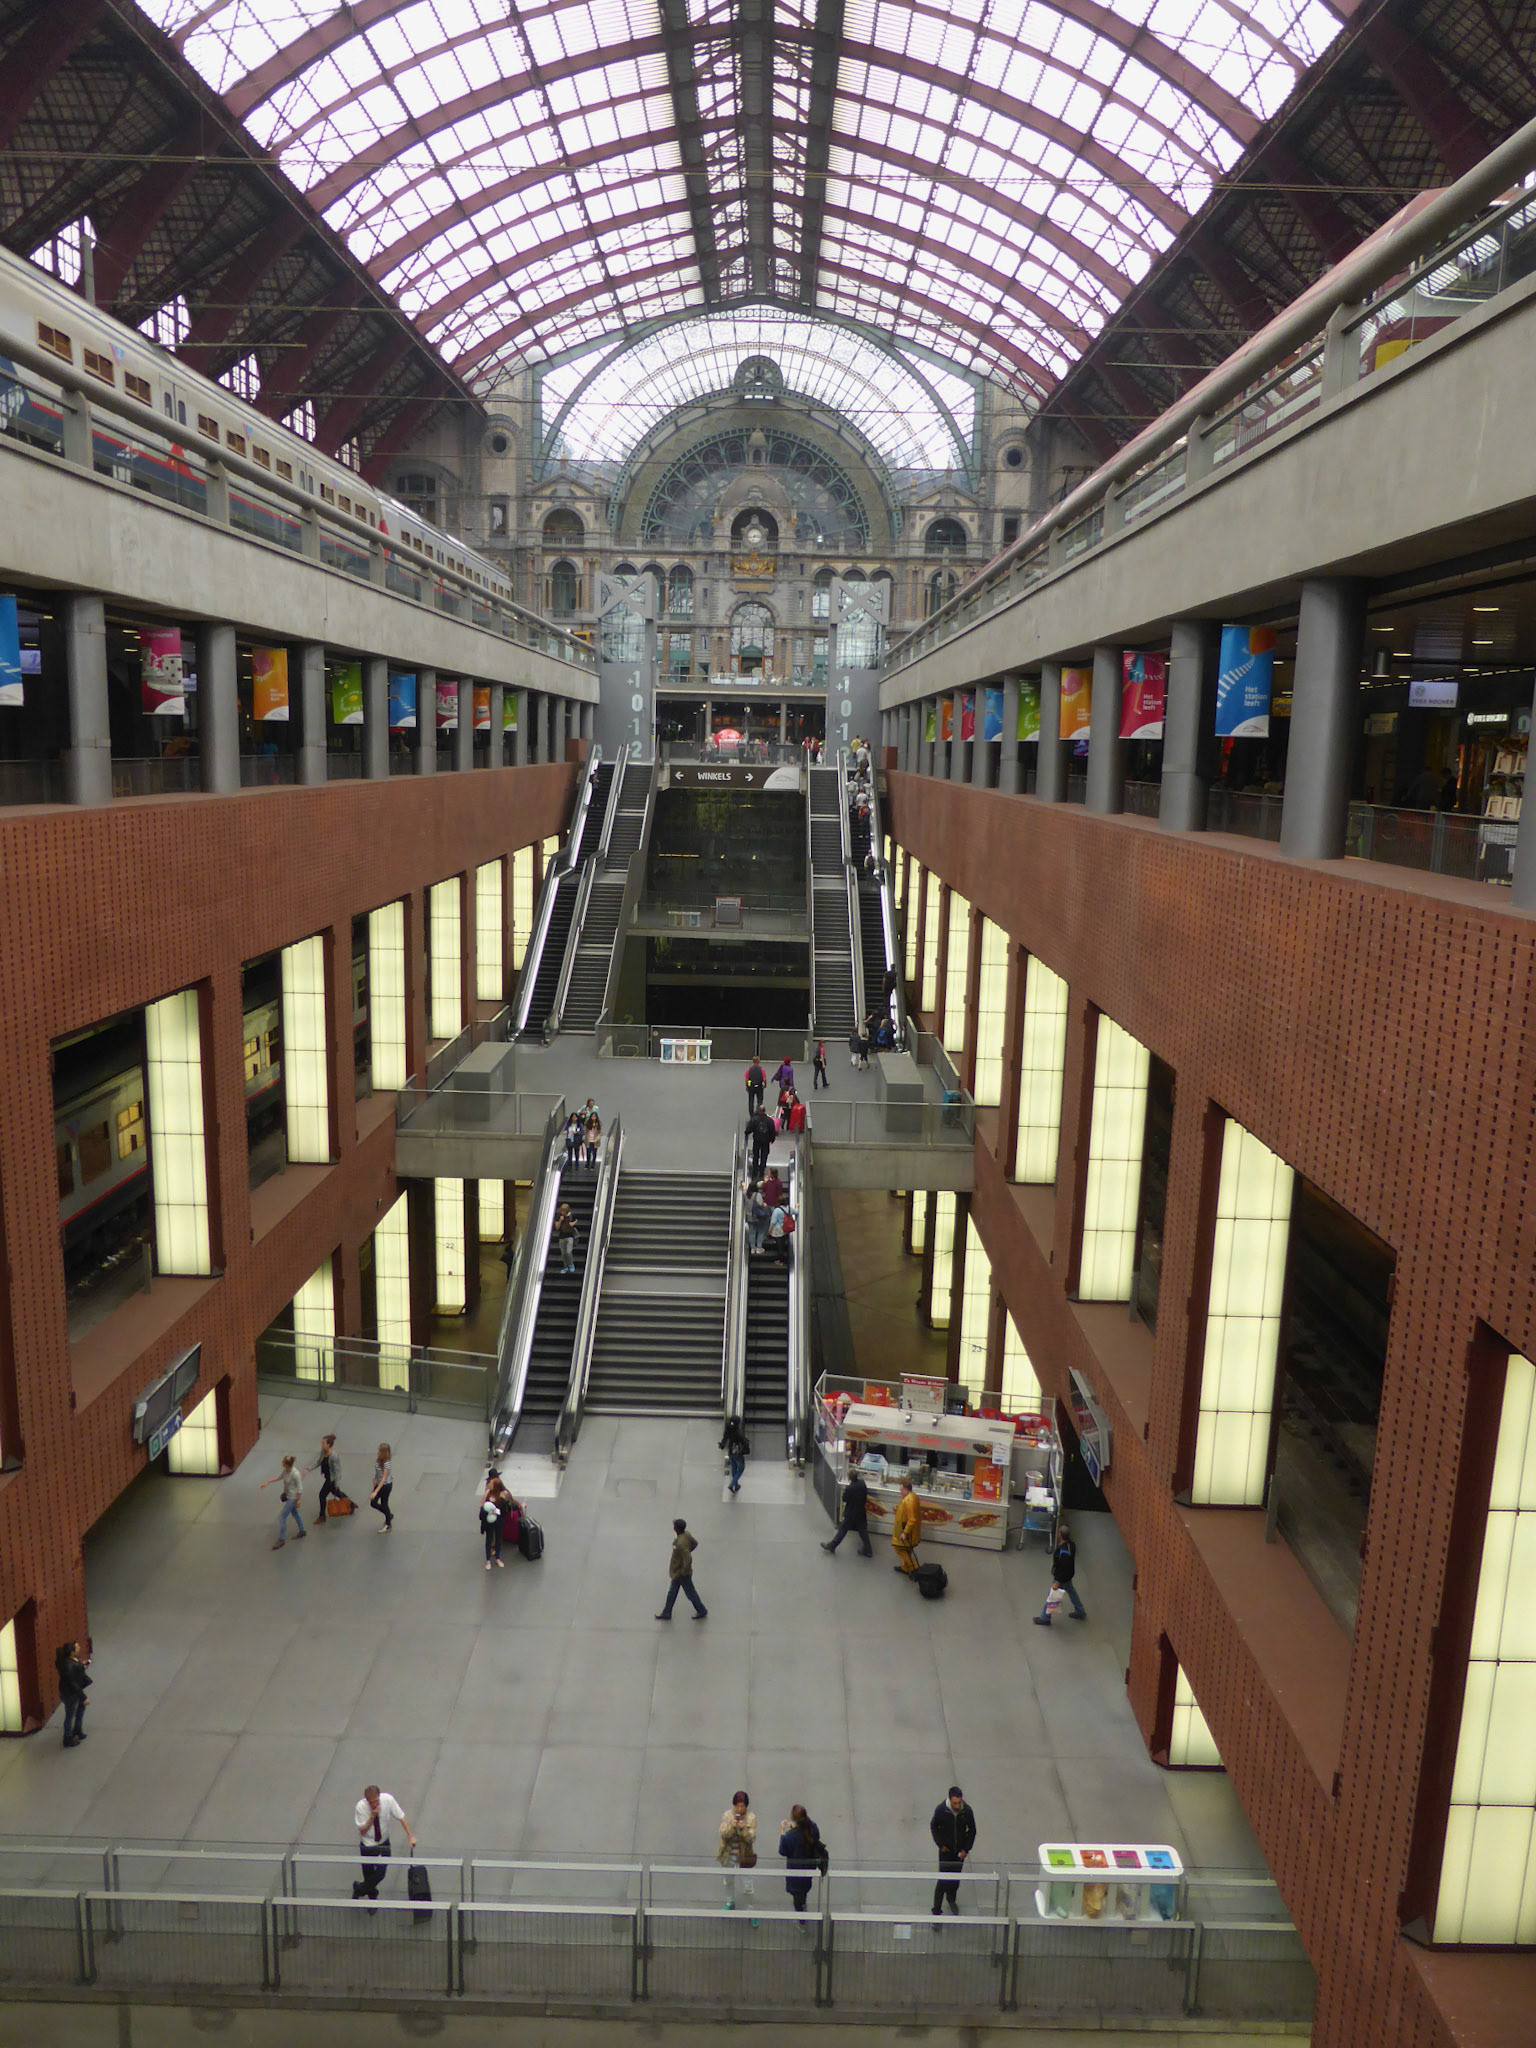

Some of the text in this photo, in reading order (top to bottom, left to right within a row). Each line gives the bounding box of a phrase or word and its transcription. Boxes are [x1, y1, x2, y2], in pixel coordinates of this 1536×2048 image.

[626, 670, 641, 688] +1
[836, 675, 850, 693] +1
[631, 694, 643, 712] 0
[1244, 692, 1268, 700] station
[1244, 699, 1261, 707] leeft
[840, 699, 852, 717] 0
[627, 718, 640, 736] -1
[835, 722, 849, 741] -1
[697, 772, 732, 781] WINKELS
